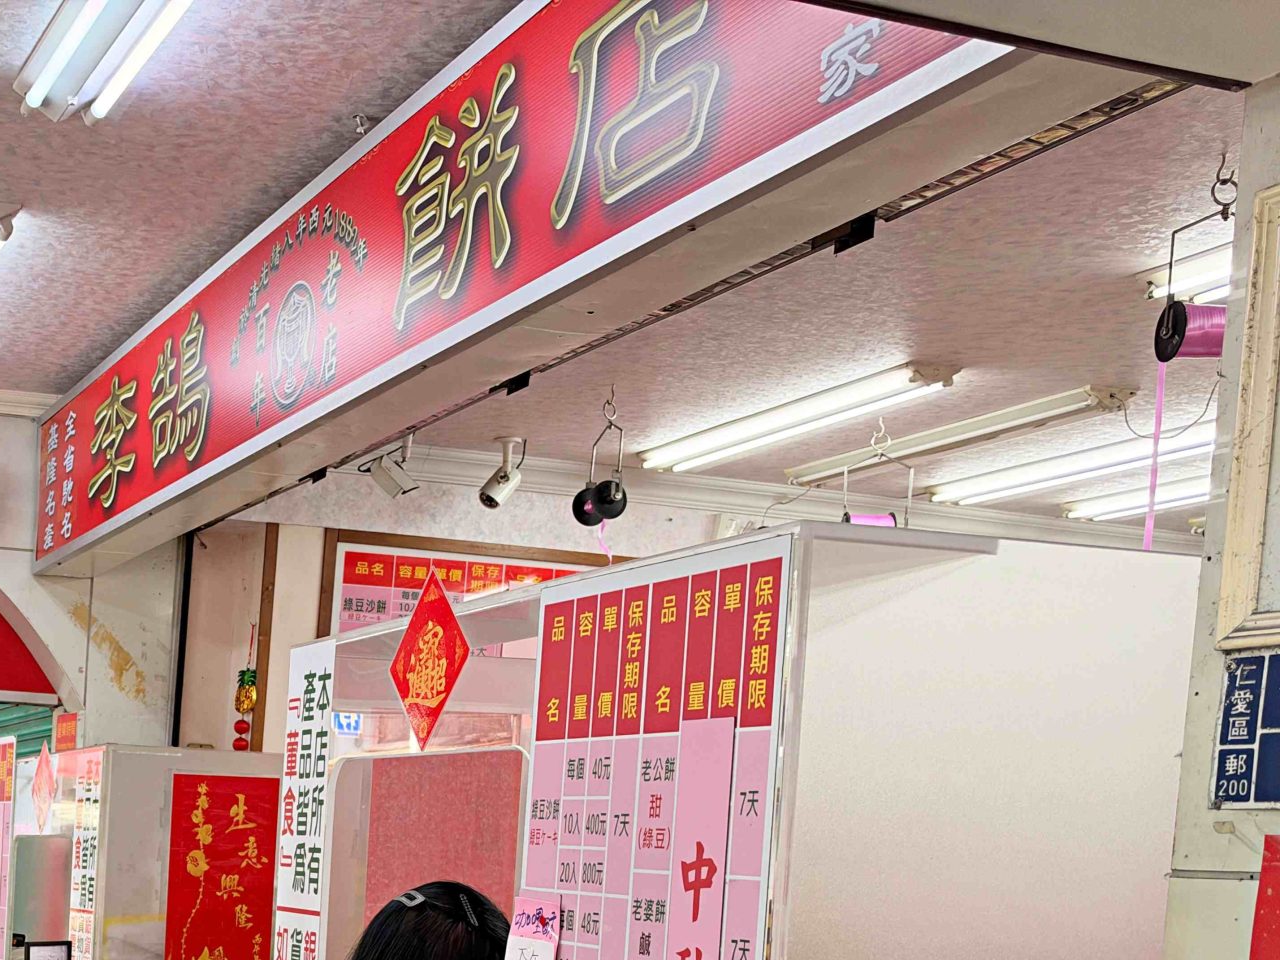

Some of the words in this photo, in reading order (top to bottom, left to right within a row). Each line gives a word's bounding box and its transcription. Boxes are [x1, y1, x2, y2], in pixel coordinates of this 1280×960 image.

[817, 17, 881, 105] 家
[60, 410, 77, 541] 全省馳名
[355, 561, 385, 577] 品名
[398, 564, 428, 580] 容量
[655, 595, 678, 714] 品名
[686, 589, 712, 712] 容量
[716, 583, 742, 710] 單價
[746, 576, 775, 711] 保存期限
[545, 616, 566, 723] 品名
[573, 611, 595, 721] 容量
[597, 607, 619, 719] 單價
[621, 600, 645, 721] 保存期限
[1225, 663, 1257, 741] 仁愛區
[567, 757, 585, 783] 每個
[592, 757, 611, 782] 40元
[641, 758, 675, 784] 老公餅
[1225, 753, 1247, 777] 郵
[308, 667, 331, 895] 本店所有
[1218, 779, 1249, 797] 200
[531, 799, 559, 822] 綠豆沙餅
[648, 793, 663, 819] 甜
[739, 790, 760, 818] 7天
[563, 813, 581, 836] 10入
[585, 813, 608, 837] 400元
[613, 814, 630, 838] 7天
[637, 828, 672, 851] (綠豆)
[216, 793, 269, 931] 生意興隆
[559, 861, 578, 885] 20入
[582, 861, 604, 887] 800元
[581, 912, 600, 936] 48元
[632, 899, 667, 925] 老婆餅
